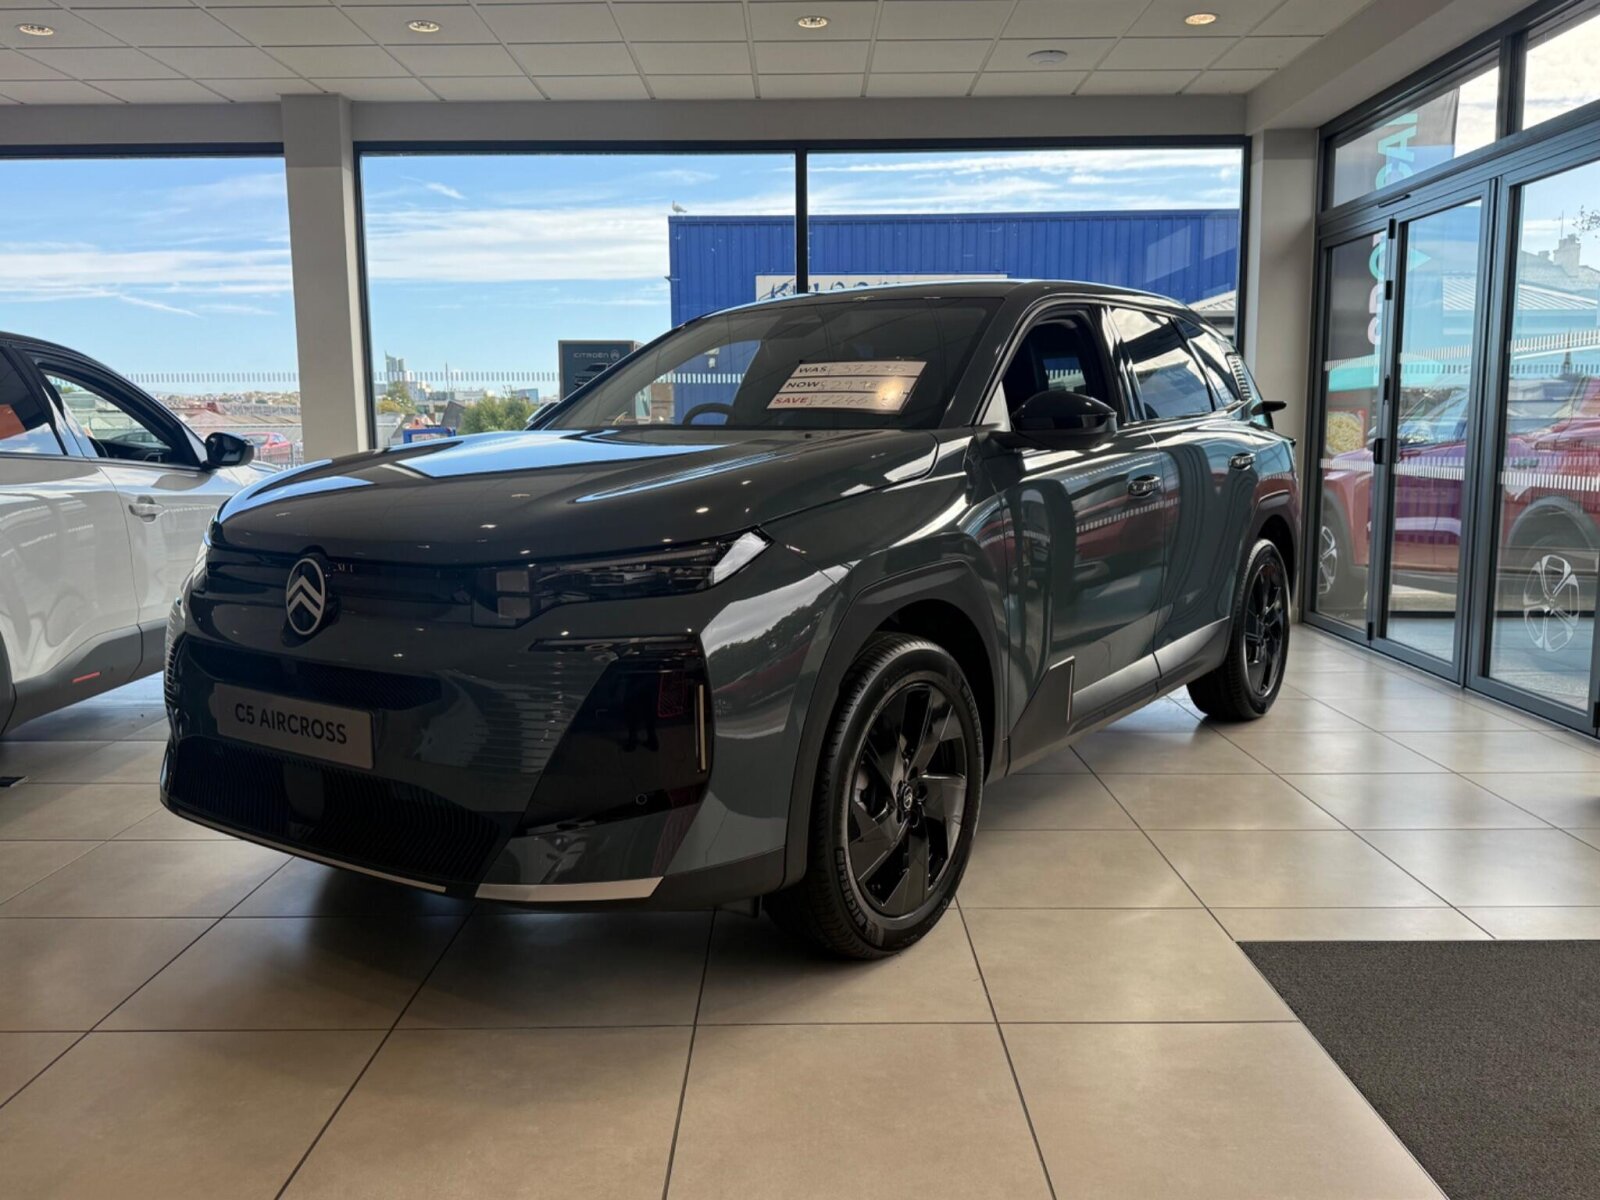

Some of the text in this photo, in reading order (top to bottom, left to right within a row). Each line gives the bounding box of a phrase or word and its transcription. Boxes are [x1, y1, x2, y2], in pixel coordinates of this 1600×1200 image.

[799, 366, 827, 374] WAS
[786, 381, 820, 389] NOW
[774, 397, 808, 405] SAVE
[235, 703, 347, 744] C5 AIRCROSS
